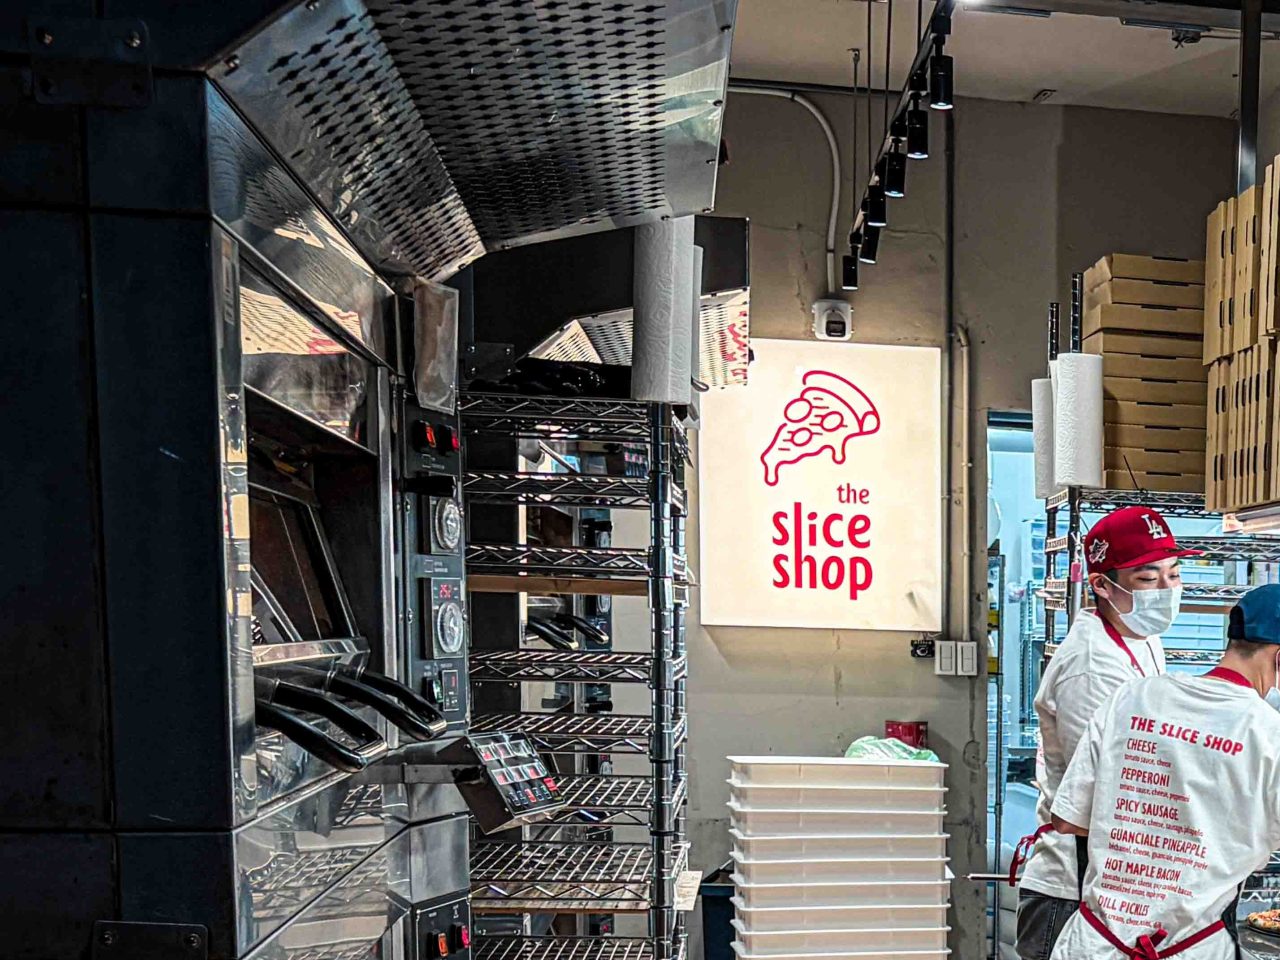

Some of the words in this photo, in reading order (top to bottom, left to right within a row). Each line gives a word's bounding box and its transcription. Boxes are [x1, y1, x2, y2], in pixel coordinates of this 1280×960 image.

[837, 483, 870, 504] the
[772, 502, 871, 548] slice
[1141, 514, 1168, 539] LA
[772, 551, 873, 600] shop
[1127, 738, 1158, 754] CHEESE
[1130, 716, 1156, 733] THE
[1159, 722, 1200, 744] SLICE
[1203, 735, 1244, 756] SHOP
[1121, 767, 1170, 787] PEPPERONI
[1116, 797, 1140, 813] SPICY
[1142, 802, 1179, 820] SAUSAGE
[1110, 828, 1160, 848] GUANCIALE
[1162, 837, 1207, 858] PINEAPPLE
[1104, 857, 1123, 872] HOT
[1126, 861, 1155, 878] MAPLE
[1156, 868, 1181, 882] BACON
[1097, 895, 1117, 910] DILL
[1120, 900, 1150, 917] PICKLES
